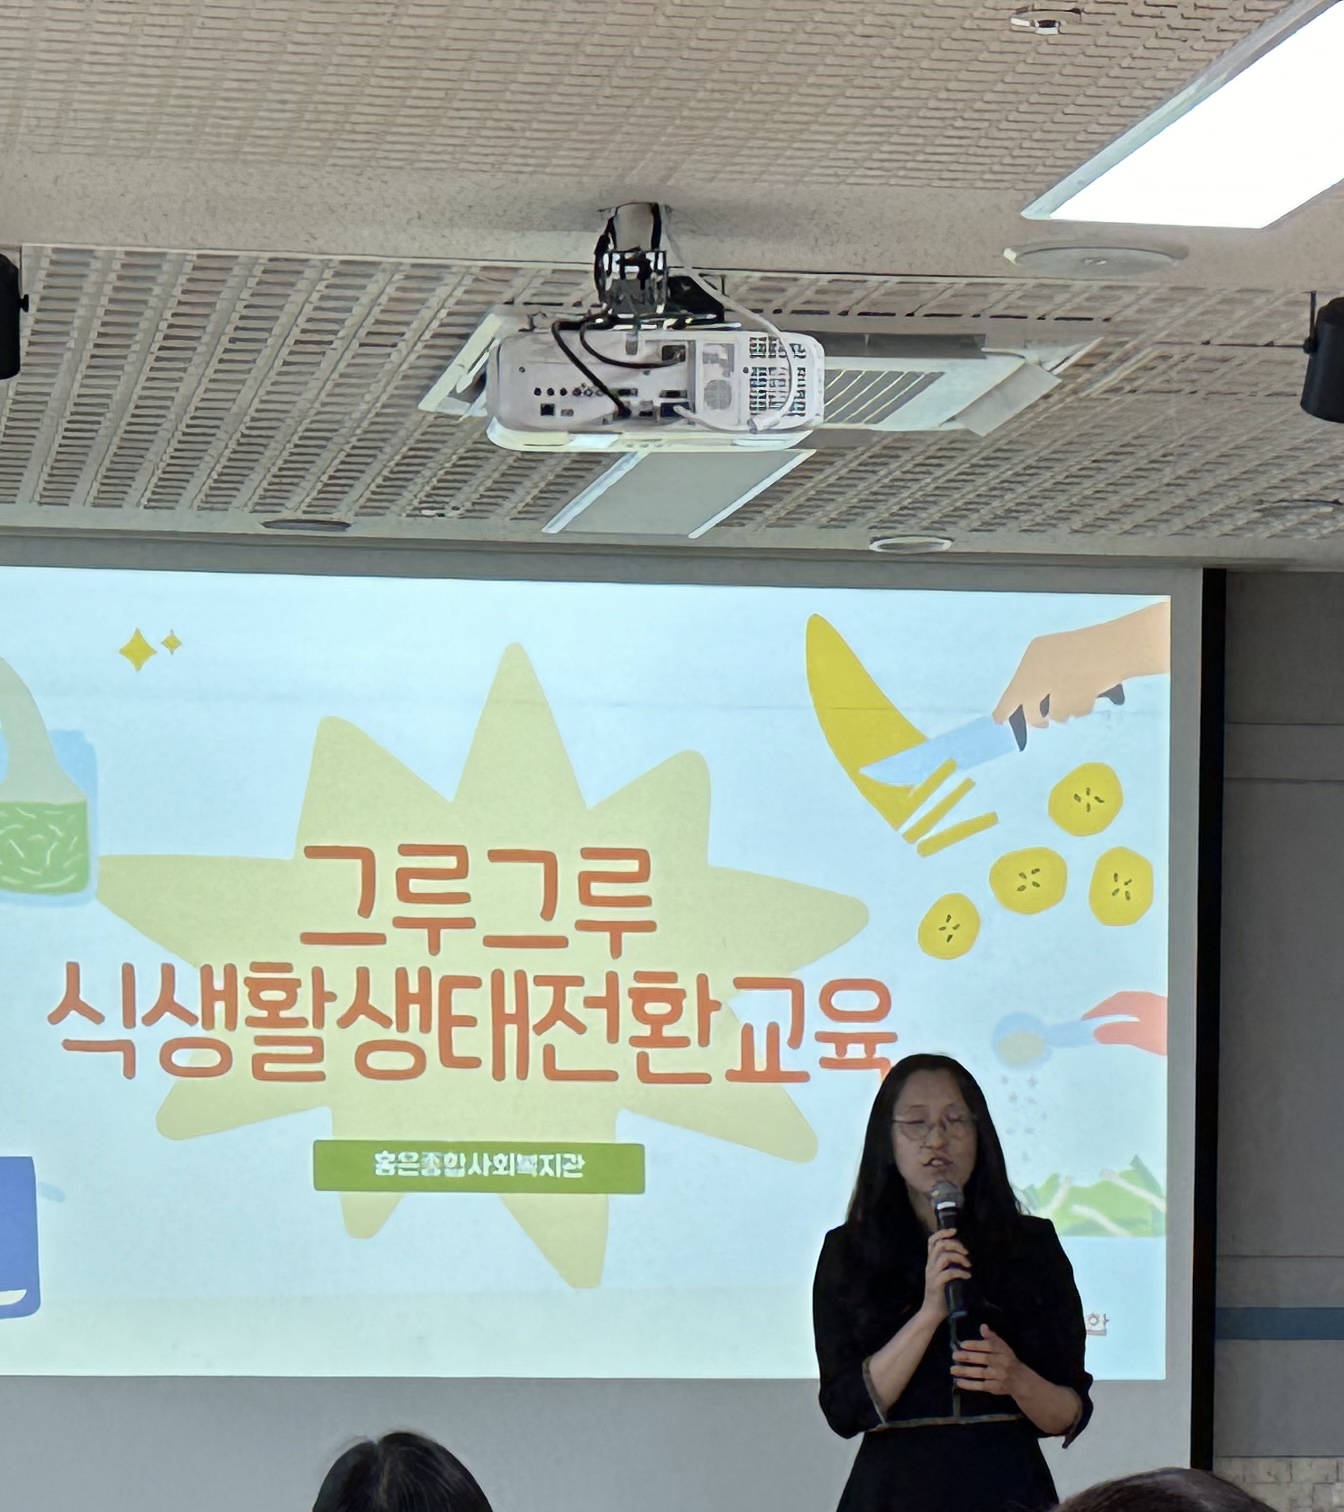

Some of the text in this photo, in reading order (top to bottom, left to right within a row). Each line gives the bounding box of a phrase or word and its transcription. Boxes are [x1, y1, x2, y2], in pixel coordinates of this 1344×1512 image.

[300, 843, 658, 959] 그루그루
[47, 961, 898, 1085] 식생활생태전환교육
[373, 1150, 586, 1178] 홍은종합사회복지관
